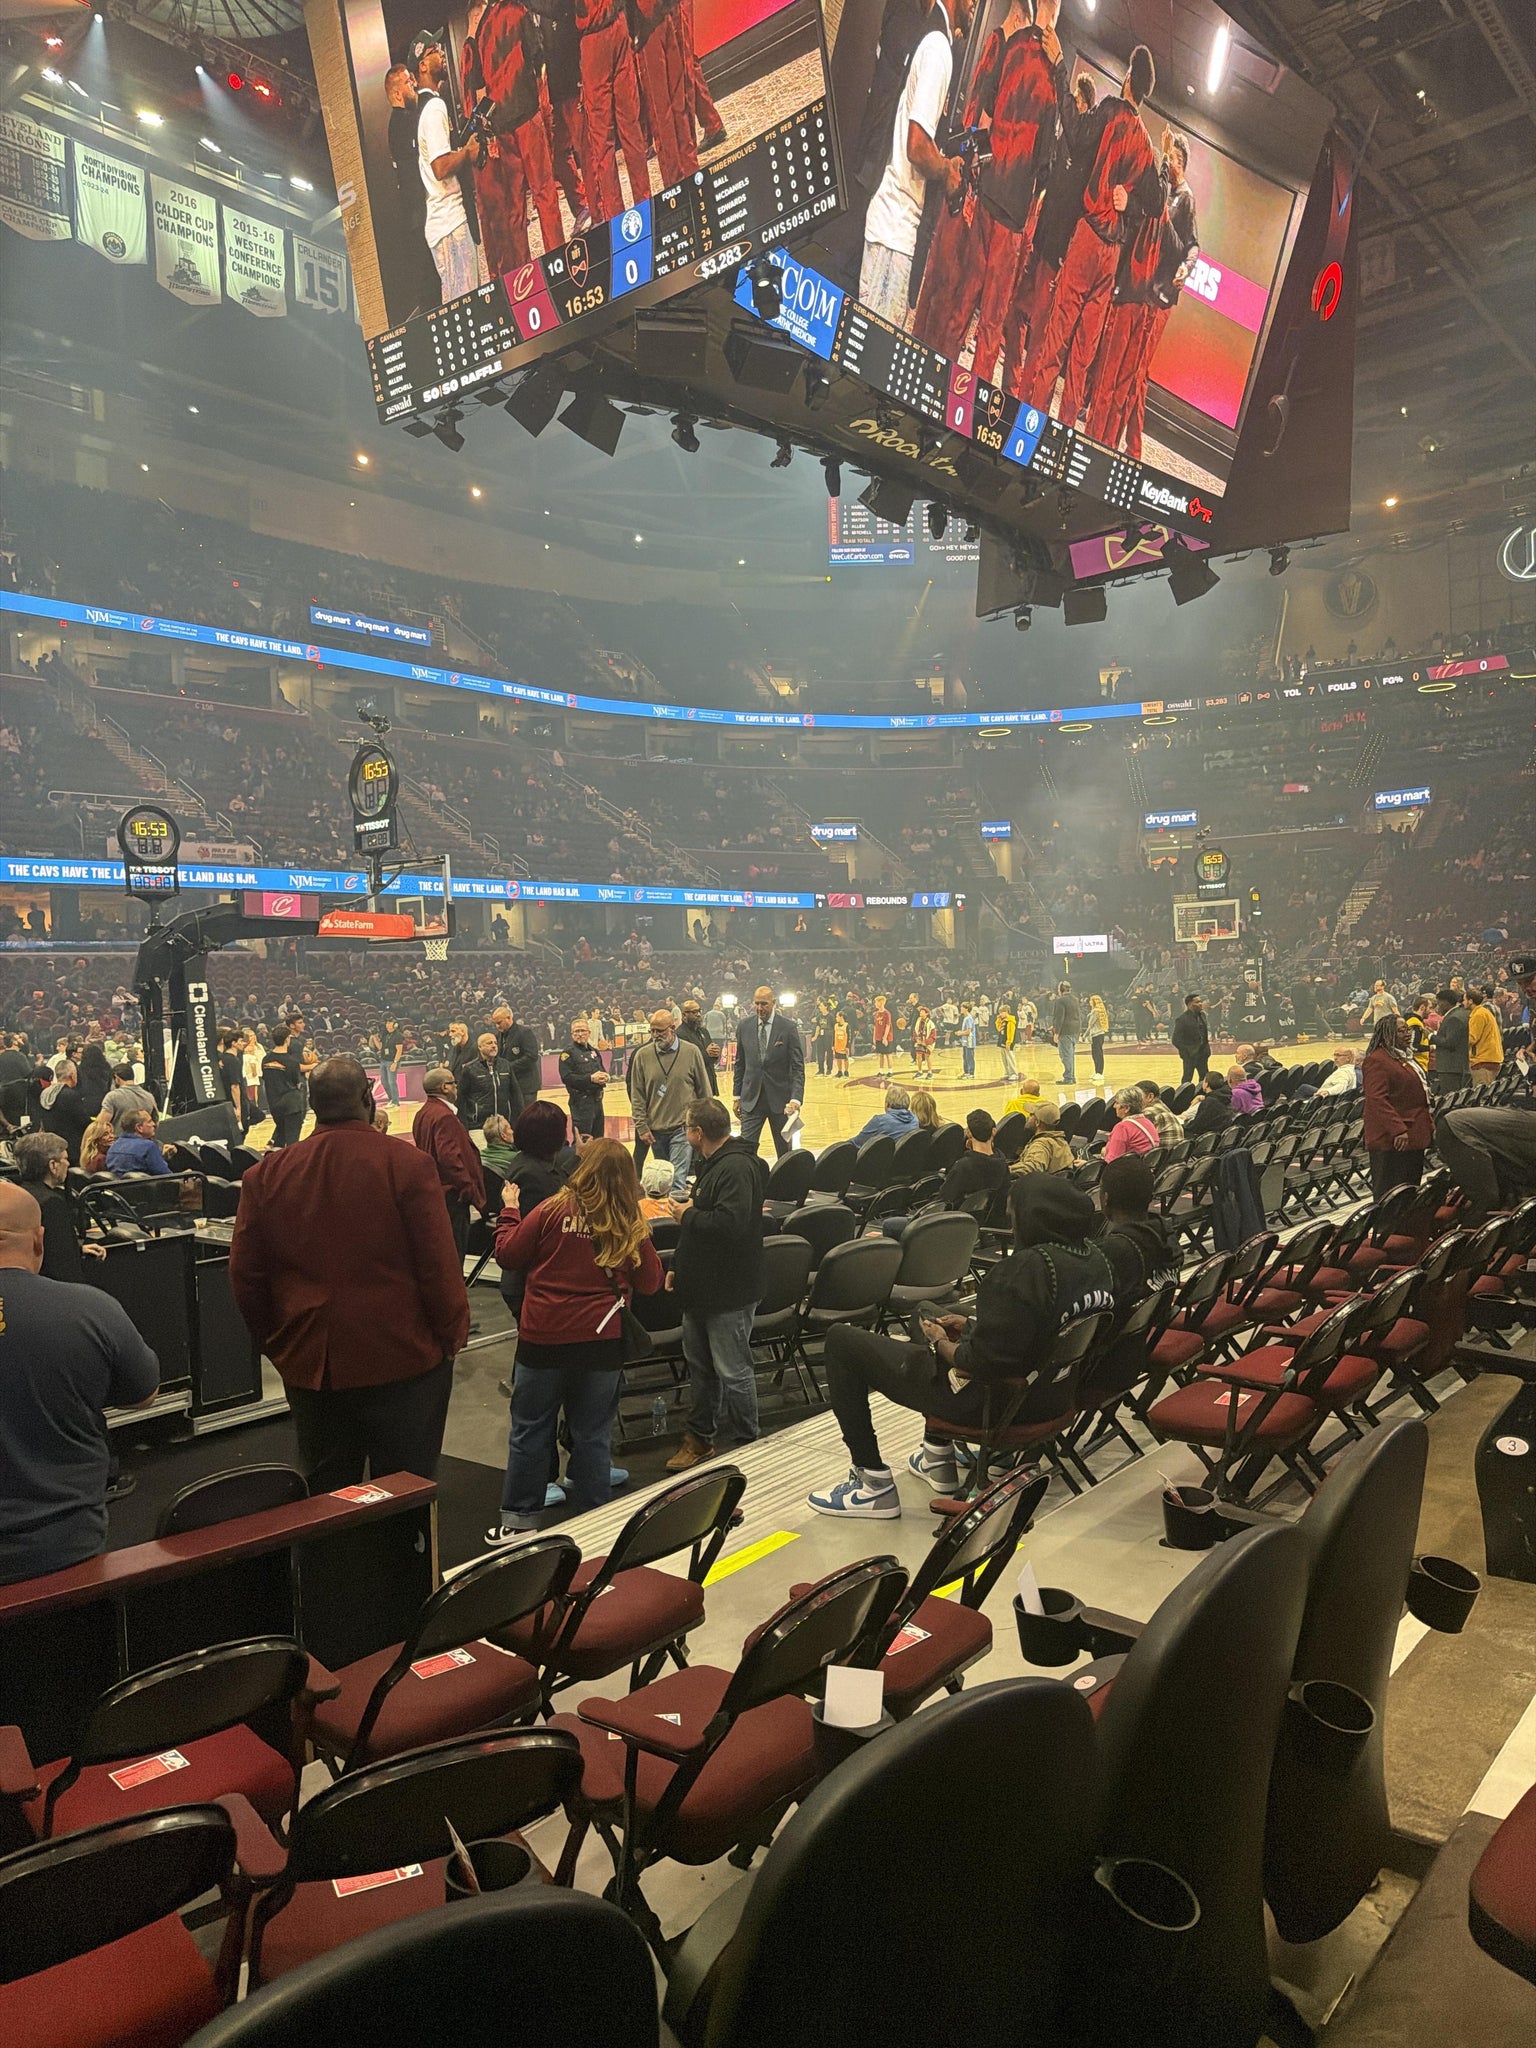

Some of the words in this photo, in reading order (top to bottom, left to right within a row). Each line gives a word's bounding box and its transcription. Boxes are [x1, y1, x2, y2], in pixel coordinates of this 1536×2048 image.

[708, 141, 758, 176] TIMBERWOLVES
[764, 131, 777, 143] PTS
[779, 121, 793, 134] REB
[796, 111, 809, 125] AST
[811, 102, 824, 115] FLS
[83, 154, 106, 171] NORTH
[107, 163, 137, 183] DIVISION
[81, 163, 141, 196] CHAMPIONS
[713, 174, 729, 189] BALL
[661, 186, 682, 202] FOULS
[715, 177, 750, 202] MCDANIELS
[170, 190, 197, 210] 2016
[717, 193, 747, 215] EDWARDS
[154, 200, 193, 226] CALDER
[194, 216, 215, 233] CUP
[701, 227, 711, 239] 24
[719, 208, 748, 229] KUMINGA
[761, 194, 837, 244] CAVS5050.COM
[156, 216, 215, 249] CHAMPIONS
[232, 218, 275, 244] 2015-16
[703, 240, 713, 252] 27
[721, 223, 746, 242] GOBERT
[234, 234, 276, 260] WESTERN
[661, 234, 671, 246] FG
[228, 246, 282, 276] CONFERENCE
[297, 244, 343, 270] CALLANDER
[700, 246, 742, 280] $3,283
[548, 258, 564, 277] 1Q
[625, 259, 638, 285] 0
[656, 264, 670, 276] TOL
[677, 257, 688, 267] CH
[231, 261, 281, 289] CHAMPIONS
[303, 261, 340, 309] 15
[477, 283, 495, 298] FOULS
[565, 285, 604, 318] 16:53
[528, 307, 541, 330] 0
[787, 307, 809, 330] COLLEGE
[379, 325, 407, 344] CAVALIERS
[791, 323, 817, 347] MEDICINE
[484, 349, 496, 358] TOL
[502, 340, 512, 350] CH
[388, 374, 404, 387] ALLEN
[460, 360, 503, 387] RAFFLE
[389, 382, 413, 397] MITCHELL
[978, 388, 989, 403] 1Q
[386, 394, 413, 415] oswald
[954, 406, 964, 426] 0
[976, 424, 1003, 450] 16:53
[1015, 439, 1025, 457] 0
[1140, 480, 1189, 514] KeyBank
[831, 553, 884, 561] WeCutCarbon.com
[85, 609, 110, 624] NJM
[315, 611, 332, 624] drug
[333, 615, 351, 626] mart
[355, 619, 372, 631] drug
[373, 623, 390, 633] mart
[394, 627, 410, 640] drug
[410, 631, 427, 641] mart
[215, 632, 230, 643] THE
[231, 634, 249, 647] CAVS
[249, 638, 268, 649] HAVE
[268, 641, 282, 652] THE
[283, 643, 303, 656] LAND.
[411, 667, 428, 679] NJM
[1479, 660, 1487, 671] 0
[502, 684, 513, 693] THE
[513, 686, 527, 695] CAVS
[527, 688, 540, 697] HAVE
[540, 691, 551, 700] THE
[1283, 688, 1301, 698] TOL
[1308, 686, 1315, 695] 7
[1327, 682, 1357, 692] FOULS
[1364, 679, 1371, 689] 0
[1382, 675, 1403, 686] FG%
[1412, 672, 1419, 682] 0
[1167, 699, 1192, 709] oswald
[1205, 697, 1228, 707] $3,283
[653, 706, 668, 718] NJM
[735, 714, 745, 722] THE
[746, 715, 760, 723] CAVS
[760, 715, 773, 723] HAVE
[979, 715, 990, 723] THE
[991, 715, 1004, 723] CAVS
[890, 718, 906, 728] NJM
[364, 760, 389, 780] 16:53
[1375, 793, 1401, 805] drug
[1402, 789, 1430, 800] mart
[365, 819, 390, 832] TISSOT
[1145, 812, 1169, 826] drug
[1170, 811, 1197, 823] mart
[134, 821, 168, 837] 16:53
[811, 826, 833, 838] drug
[834, 826, 857, 836] mart
[981, 826, 996, 834] drug
[996, 824, 1010, 833] mart
[8, 864, 30, 877] THE
[32, 865, 59, 878] CAVS
[62, 866, 89, 879] HAVE
[91, 866, 111, 879] THE
[142, 866, 176, 874] TISSOT
[194, 871, 215, 883] LAND
[216, 872, 234, 884] HAS
[236, 873, 258, 885] NJM.
[289, 874, 313, 888] NJM
[418, 881, 433, 891] THE
[453, 883, 471, 893] HAVE
[472, 884, 486, 894] THE
[486, 884, 506, 894] LAND.
[522, 886, 535, 895] THE
[535, 886, 551, 896] LAND
[552, 887, 565, 896] HAS
[598, 888, 614, 900] NJM
[684, 892, 694, 901] THE
[694, 893, 706, 902] CAVS
[720, 894, 730, 903] THE
[755, 895, 764, 904] THE
[850, 896, 856, 906] 0
[866, 896, 908, 905] REBOUNDS
[921, 896, 928, 905] 0
[194, 1005, 211, 1064] Cleveland
[200, 1065, 217, 1099] Clinic
[1508, 1439, 1517, 1451] 3
